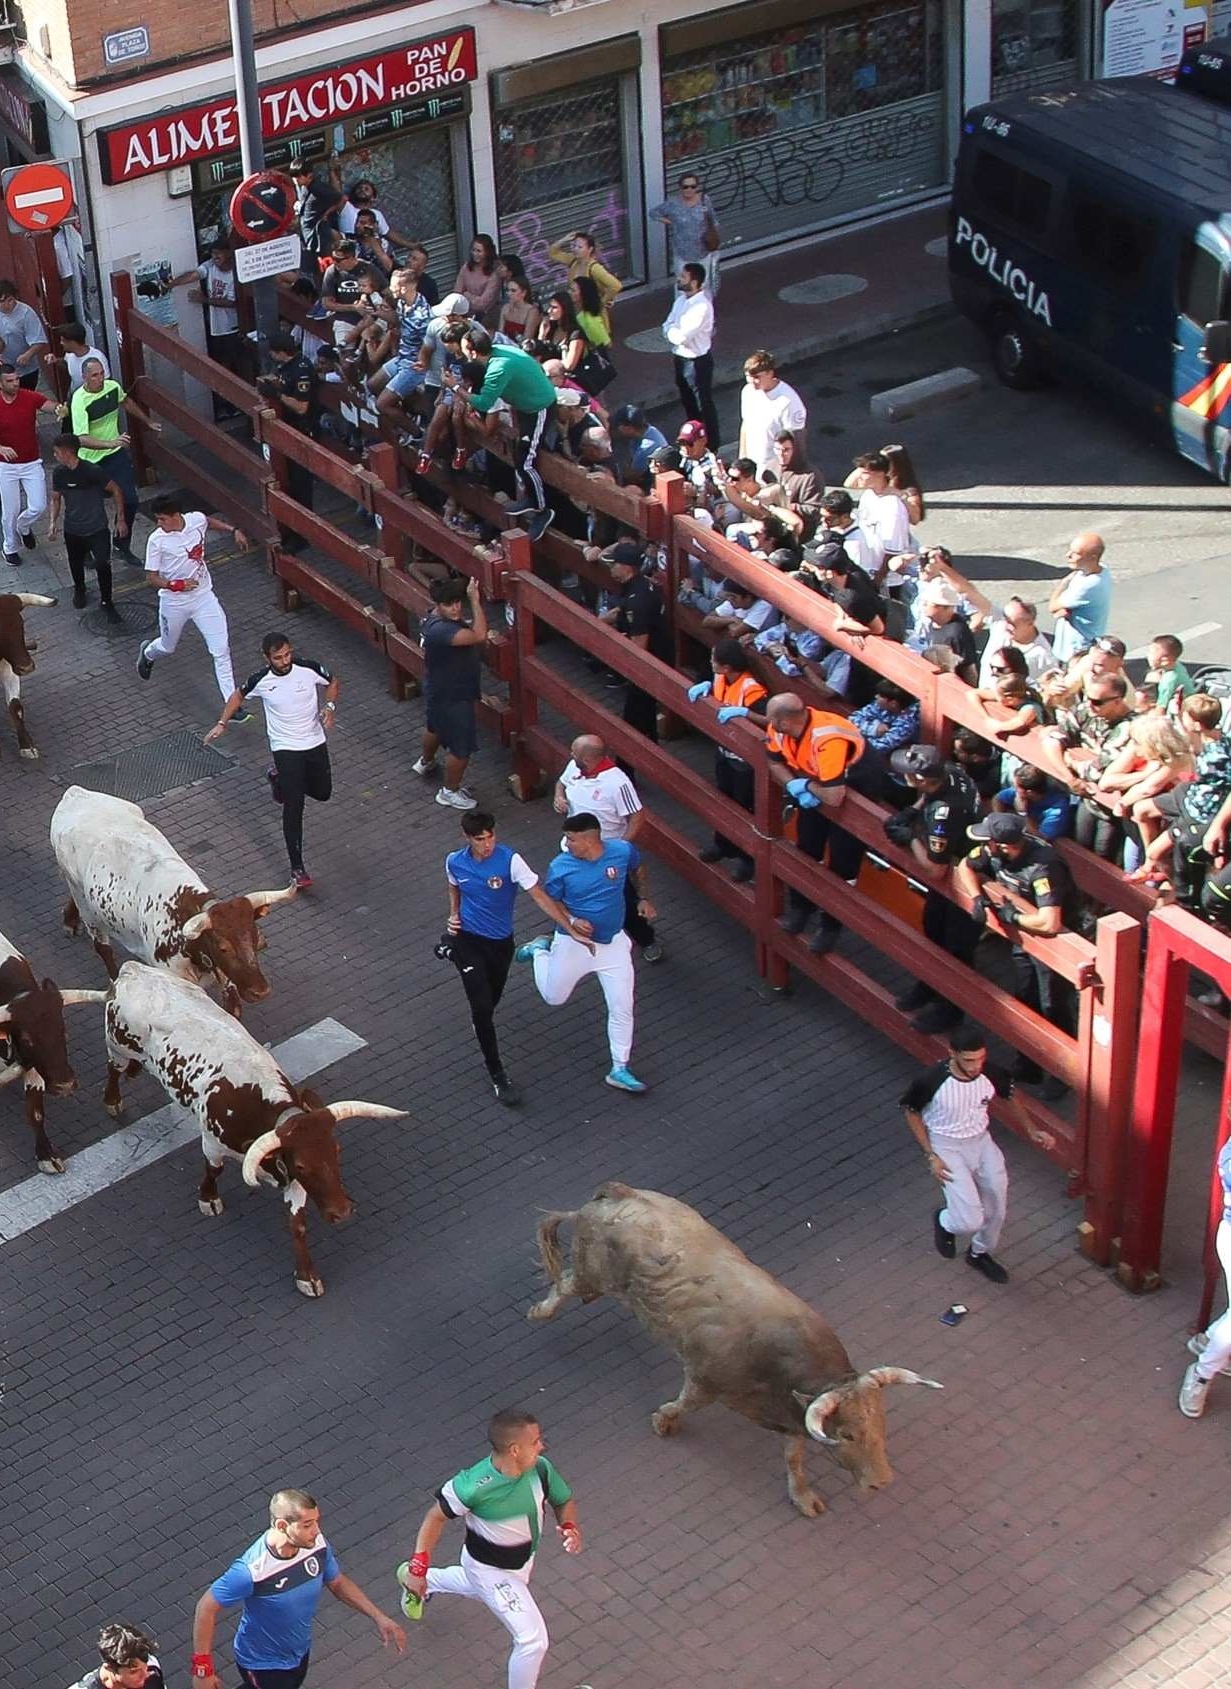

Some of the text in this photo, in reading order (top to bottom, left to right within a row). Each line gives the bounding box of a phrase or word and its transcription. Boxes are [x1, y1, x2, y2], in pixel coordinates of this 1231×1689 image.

[407, 41, 448, 65] PAN
[391, 67, 467, 101] HORNO
[415, 61, 443, 80] DE
[123, 63, 386, 175] ALIMETACION
[956, 216, 1053, 327] POLICIA
